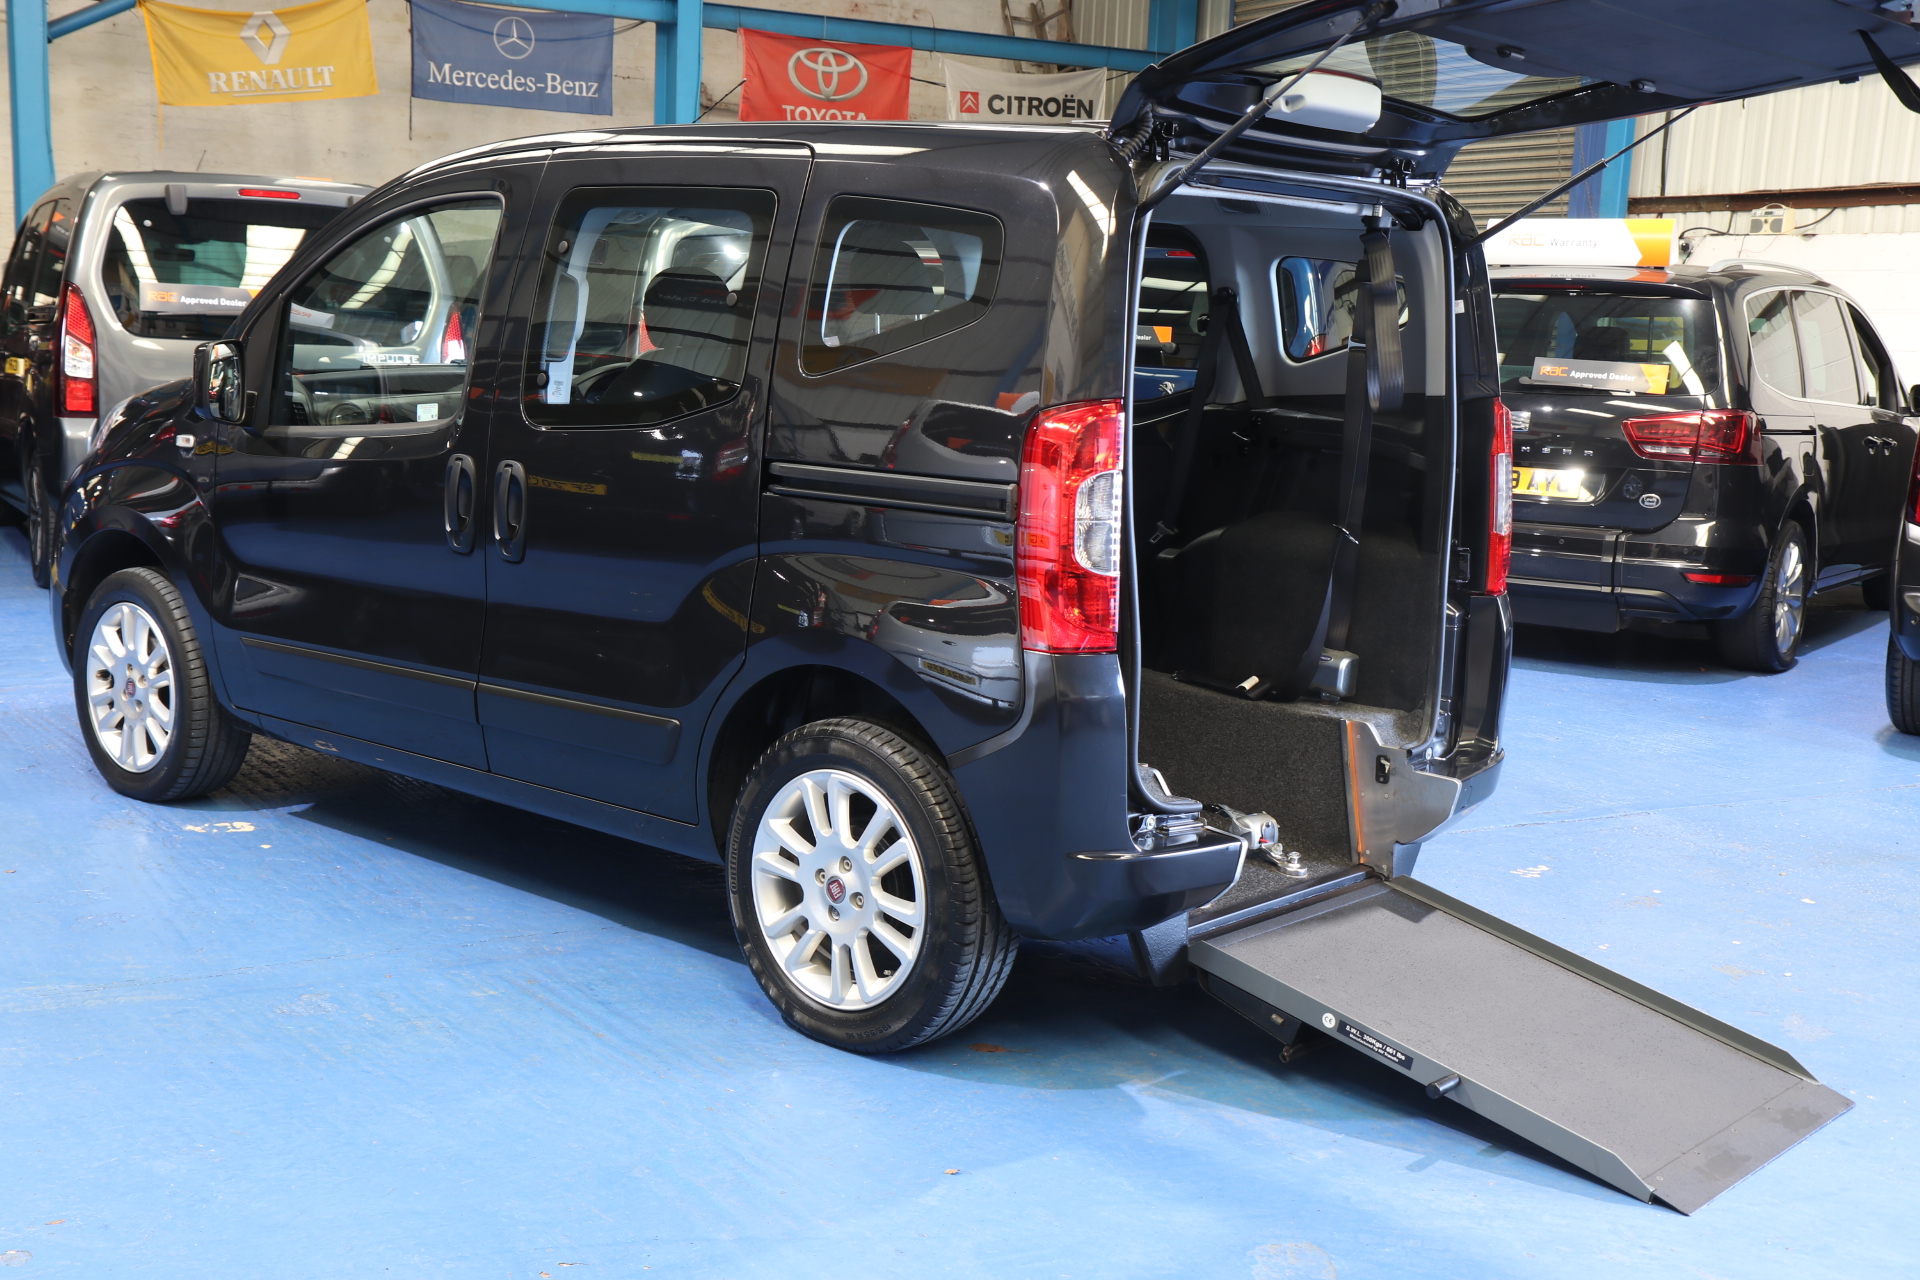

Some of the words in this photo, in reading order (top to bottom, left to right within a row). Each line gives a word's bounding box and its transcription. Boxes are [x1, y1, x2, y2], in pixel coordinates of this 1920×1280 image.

[207, 65, 334, 93] RENAULT
[428, 61, 599, 98] Mercedes-Benz
[988, 94, 1093, 119] CITROËN
[1550, 238, 1598, 249] Warranty
[180, 295, 218, 306] Approved
[220, 298, 248, 307] Dealer
[1570, 370, 1608, 380] Approved
[1609, 372, 1637, 382] Dealer
[830, 882, 843, 899] FIAT
